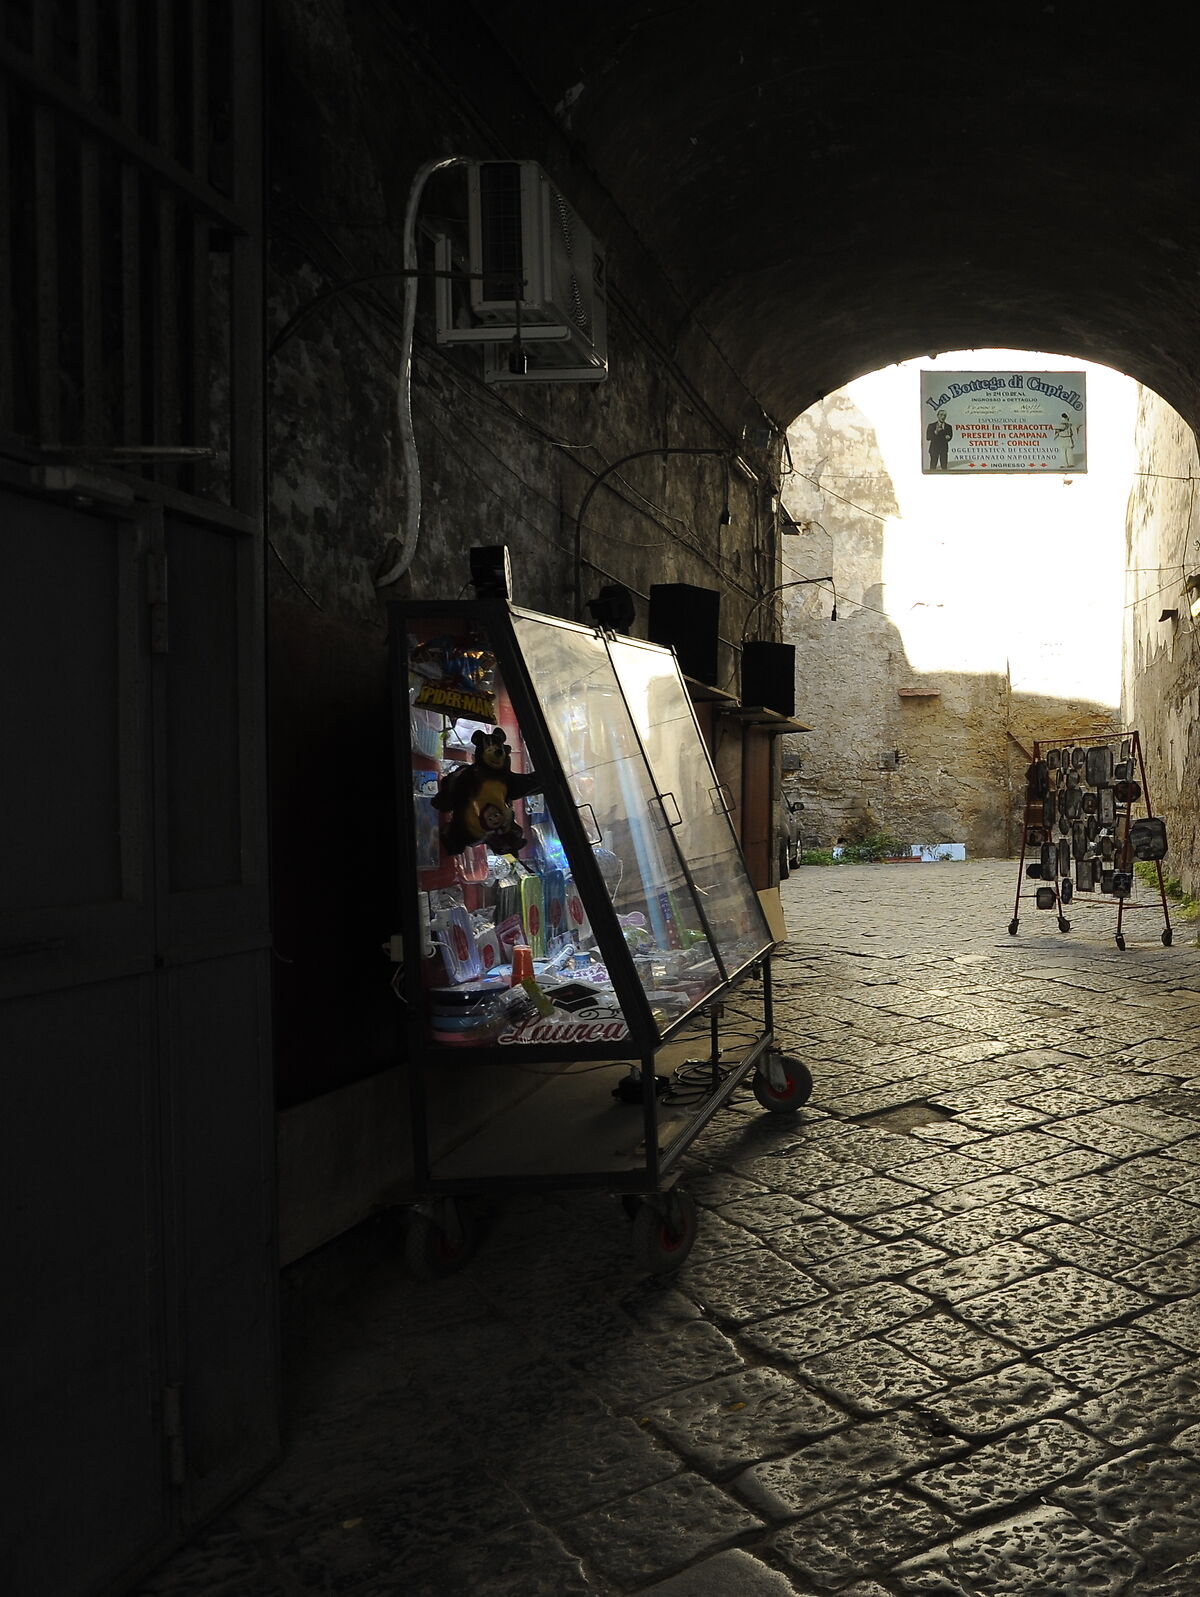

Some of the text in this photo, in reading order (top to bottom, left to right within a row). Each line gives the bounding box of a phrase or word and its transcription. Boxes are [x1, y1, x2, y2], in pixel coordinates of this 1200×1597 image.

[925, 374, 1084, 412] La Bottega di Cupiello
[416, 685, 495, 716] SPIDER-MAN
[498, 1014, 630, 1045] Laurea
